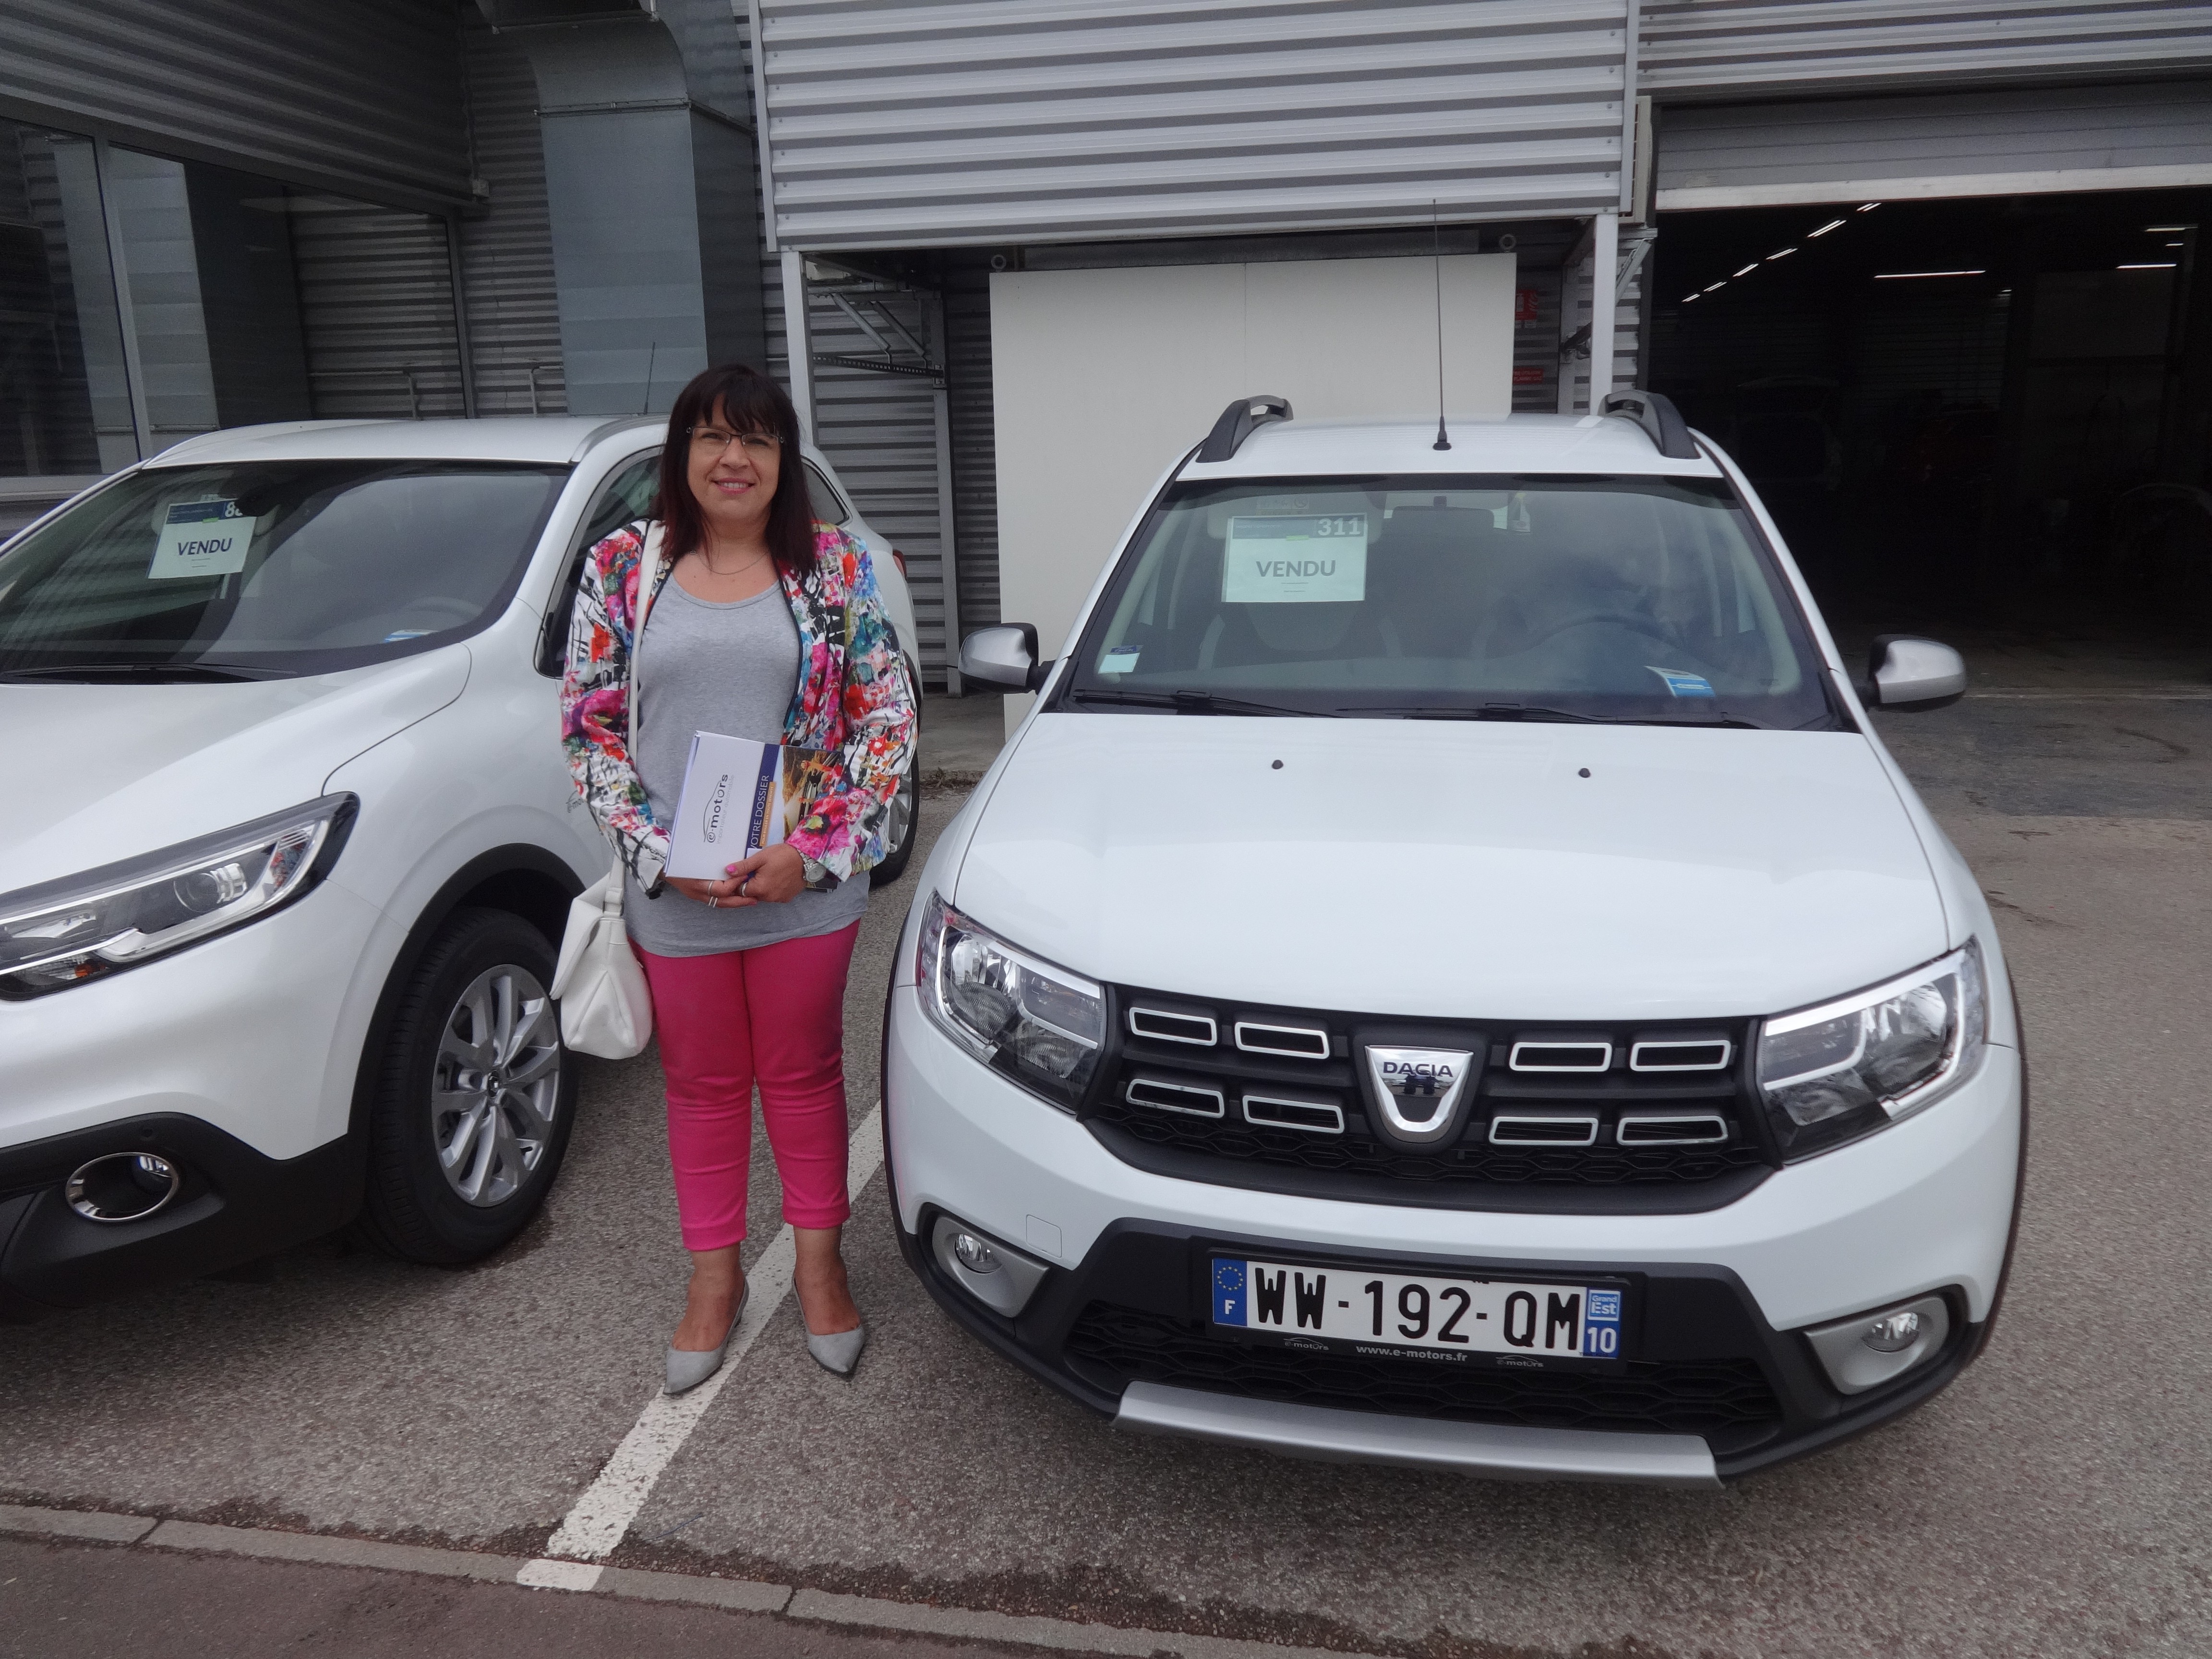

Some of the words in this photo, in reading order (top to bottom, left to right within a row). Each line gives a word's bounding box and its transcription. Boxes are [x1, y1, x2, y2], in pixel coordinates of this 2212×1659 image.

[1318, 517, 1361, 536] 311
[178, 538, 233, 556] VENDU
[1256, 560, 1336, 577] VENDU
[755, 774, 770, 817] DOSSIER
[1383, 1061, 1454, 1078] DACIA
[1225, 1299, 1236, 1315] F
[1254, 1267, 1581, 1350] WW-192-QM
[1591, 1301, 1616, 1315] Est
[1587, 1327, 1617, 1353] 10
[1356, 1345, 1467, 1362] www.e-motors.fr
